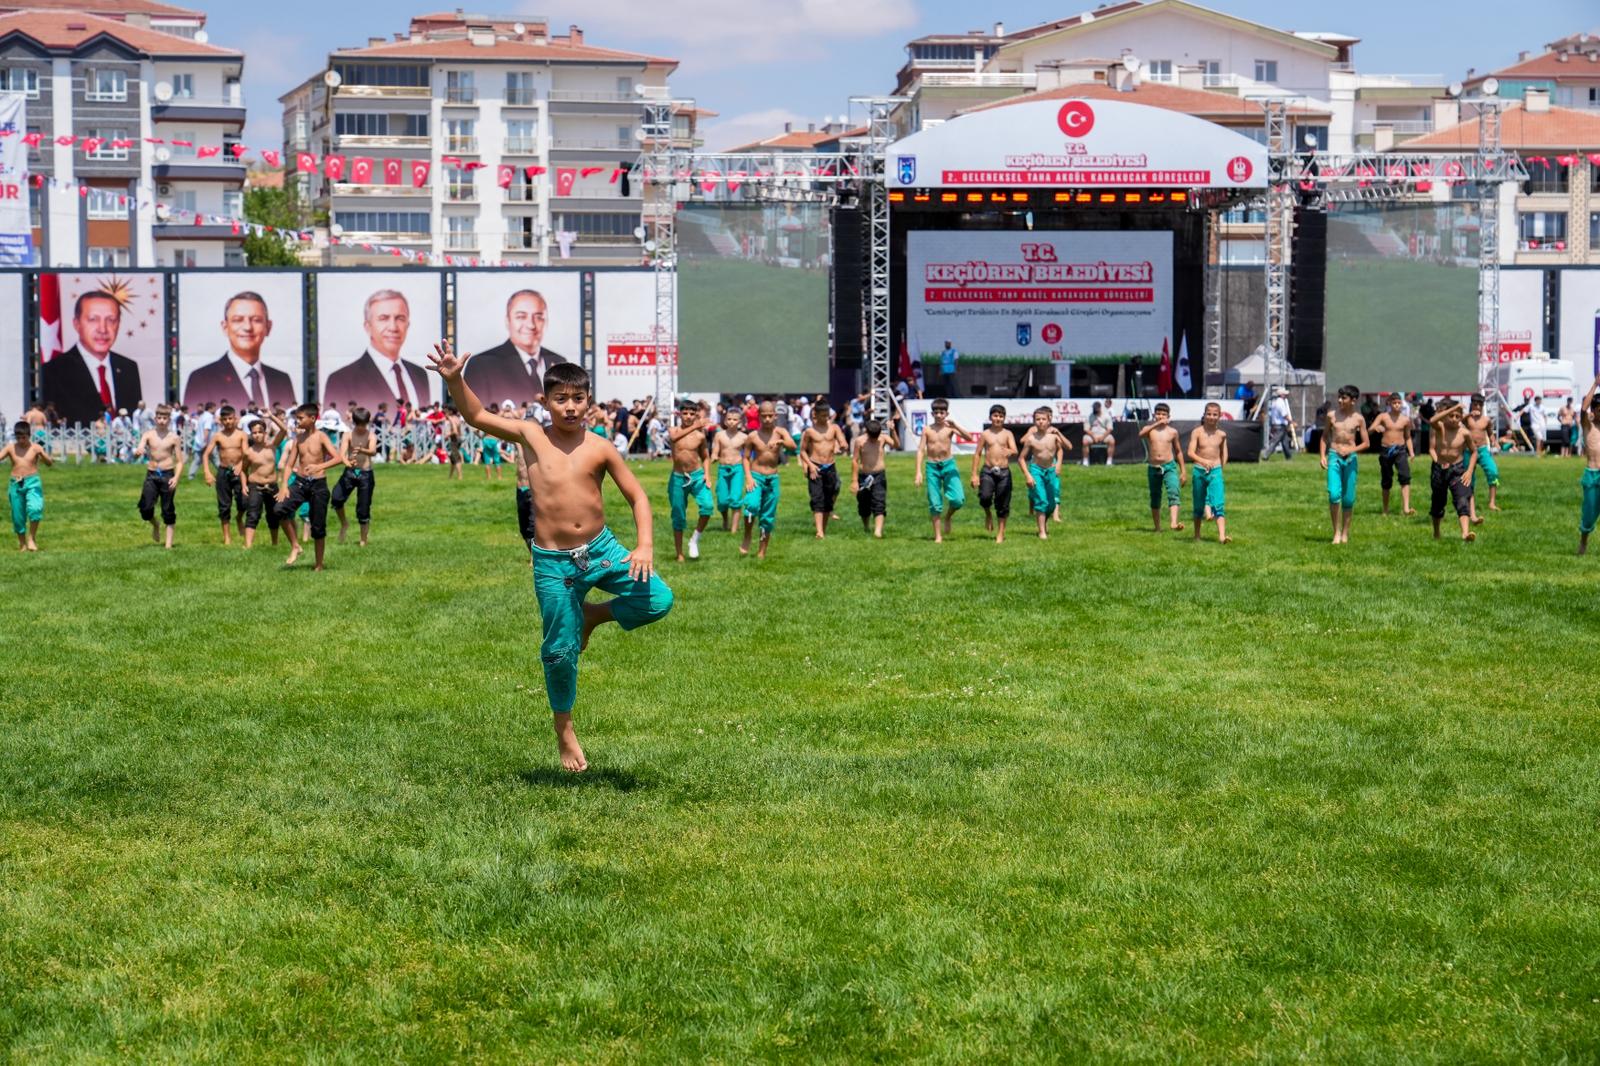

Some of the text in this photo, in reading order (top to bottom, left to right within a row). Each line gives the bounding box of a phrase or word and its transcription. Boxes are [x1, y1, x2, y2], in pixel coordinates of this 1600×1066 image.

[1005, 154, 1147, 169] KEÇİÖREN BELEDİYESİ
[947, 171, 1205, 183] 2. GELENEKSEL TAHA AKGÜL KARAKUCAK GÜREŞLERİ
[1021, 243, 1058, 262] T.C.
[926, 260, 1153, 287] KEÇİÖREN BELEDİYESİ
[608, 354, 650, 364] TAHA
